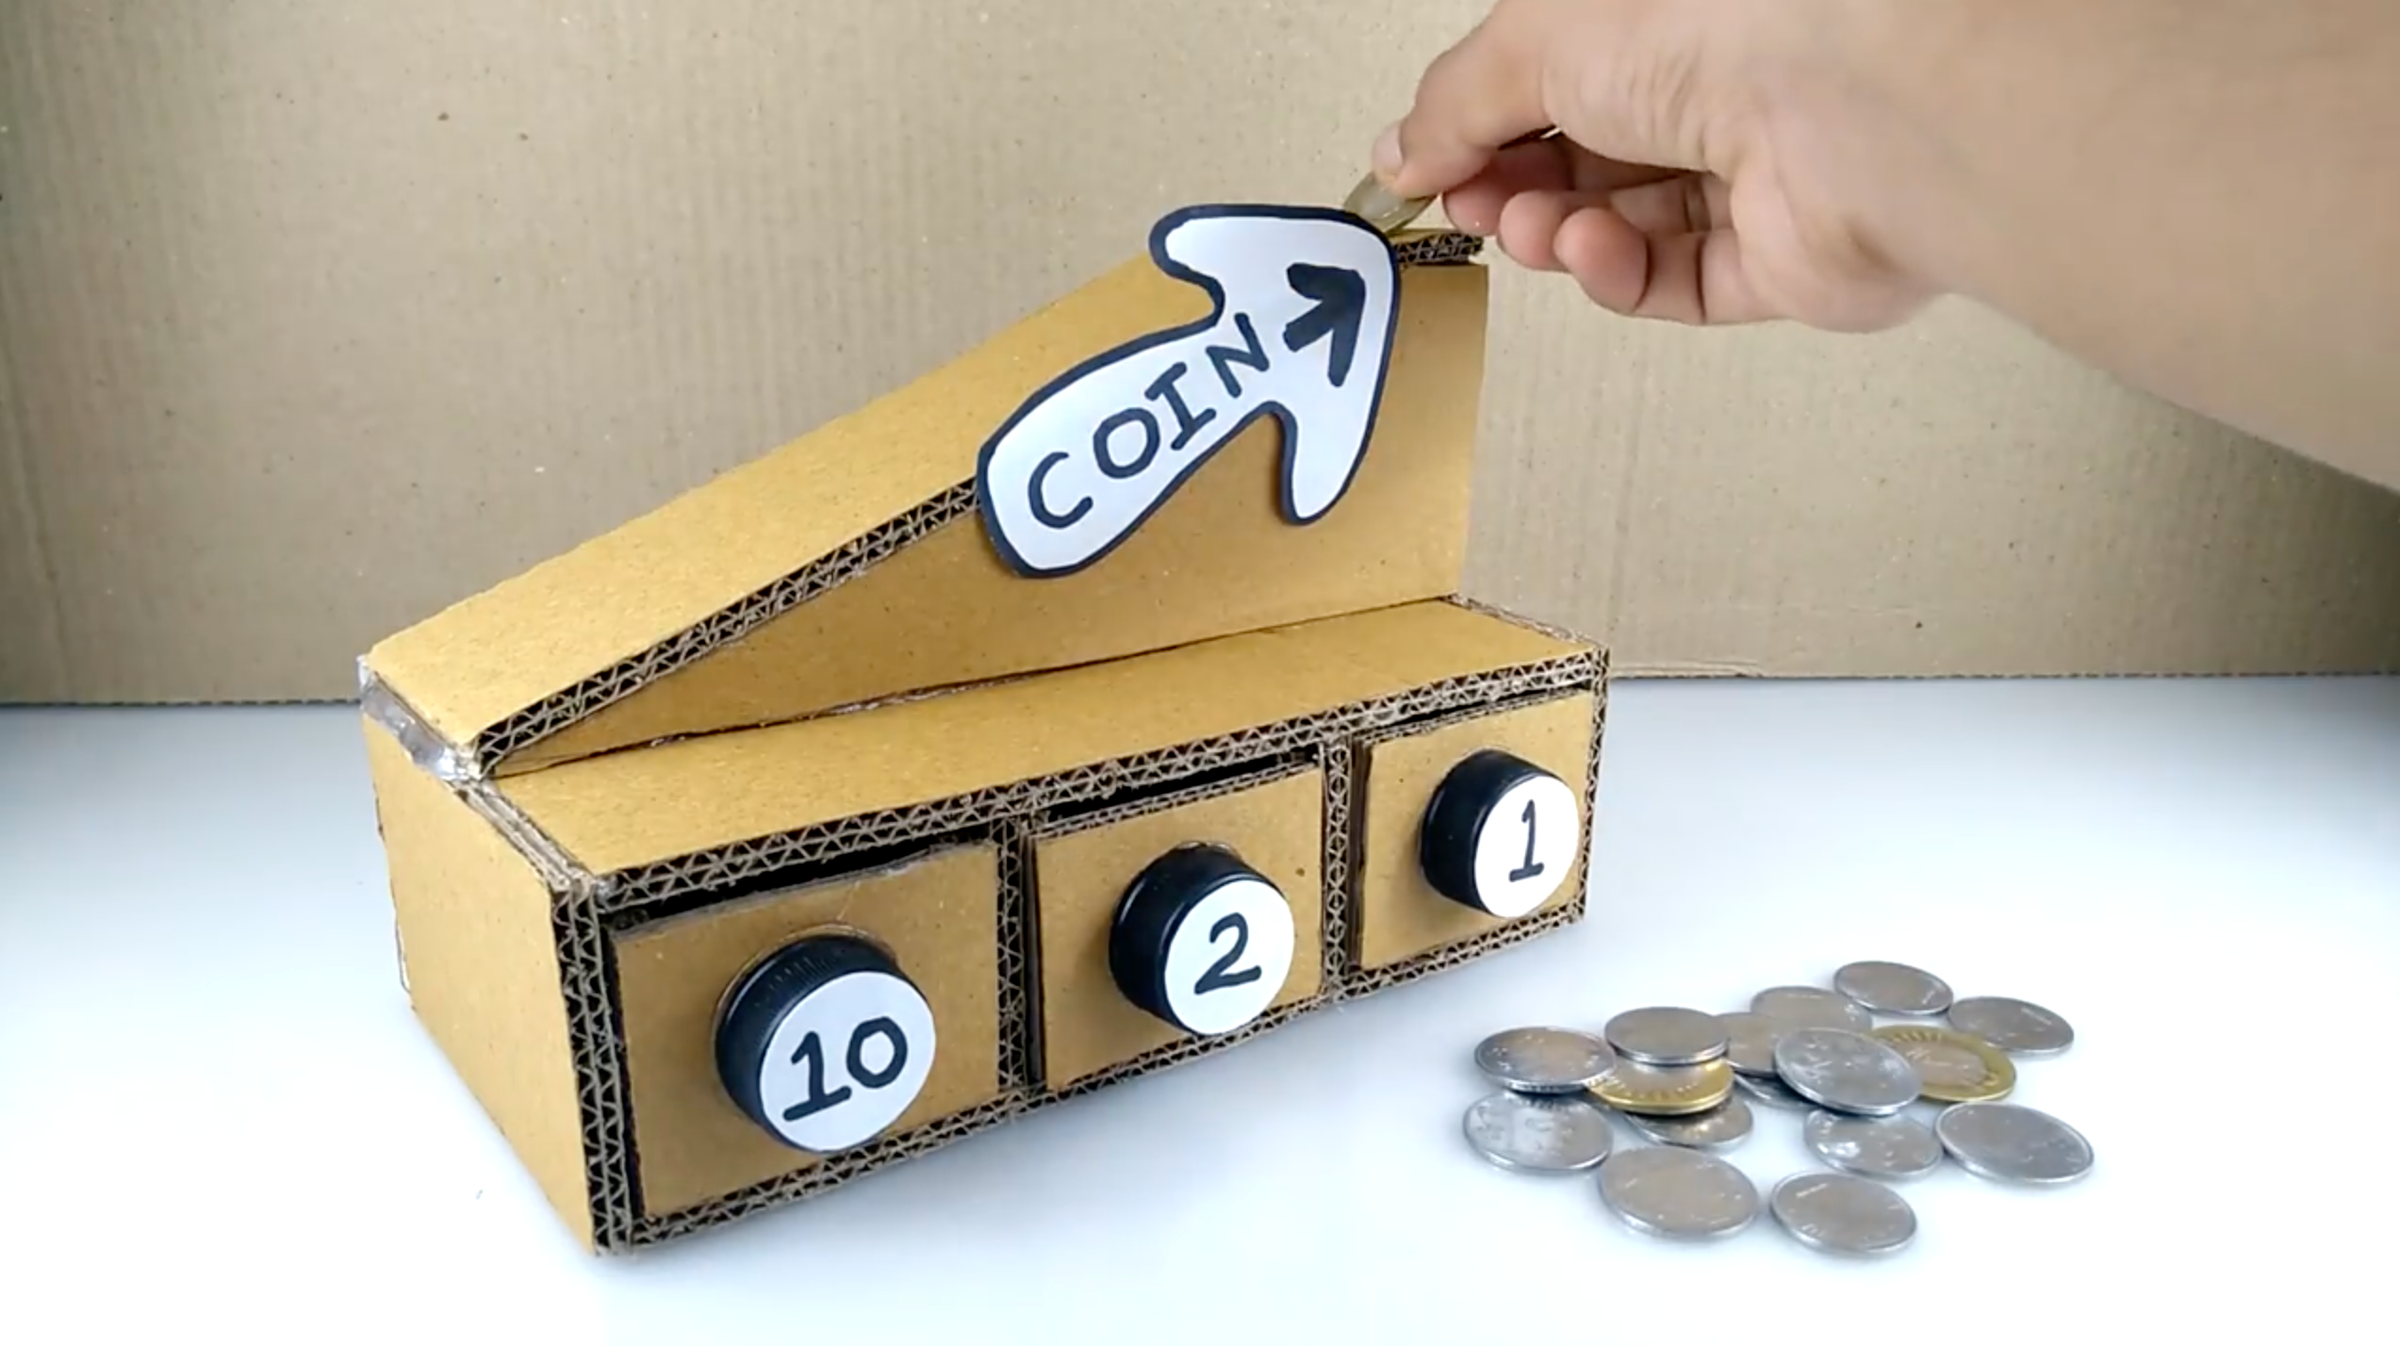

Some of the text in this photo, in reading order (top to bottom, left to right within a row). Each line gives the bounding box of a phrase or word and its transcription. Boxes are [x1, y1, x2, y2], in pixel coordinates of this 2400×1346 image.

[1027, 313, 1270, 528] COIN
[1509, 799, 1544, 883] 1
[1194, 912, 1262, 995] 2
[783, 1016, 908, 1122] 10
